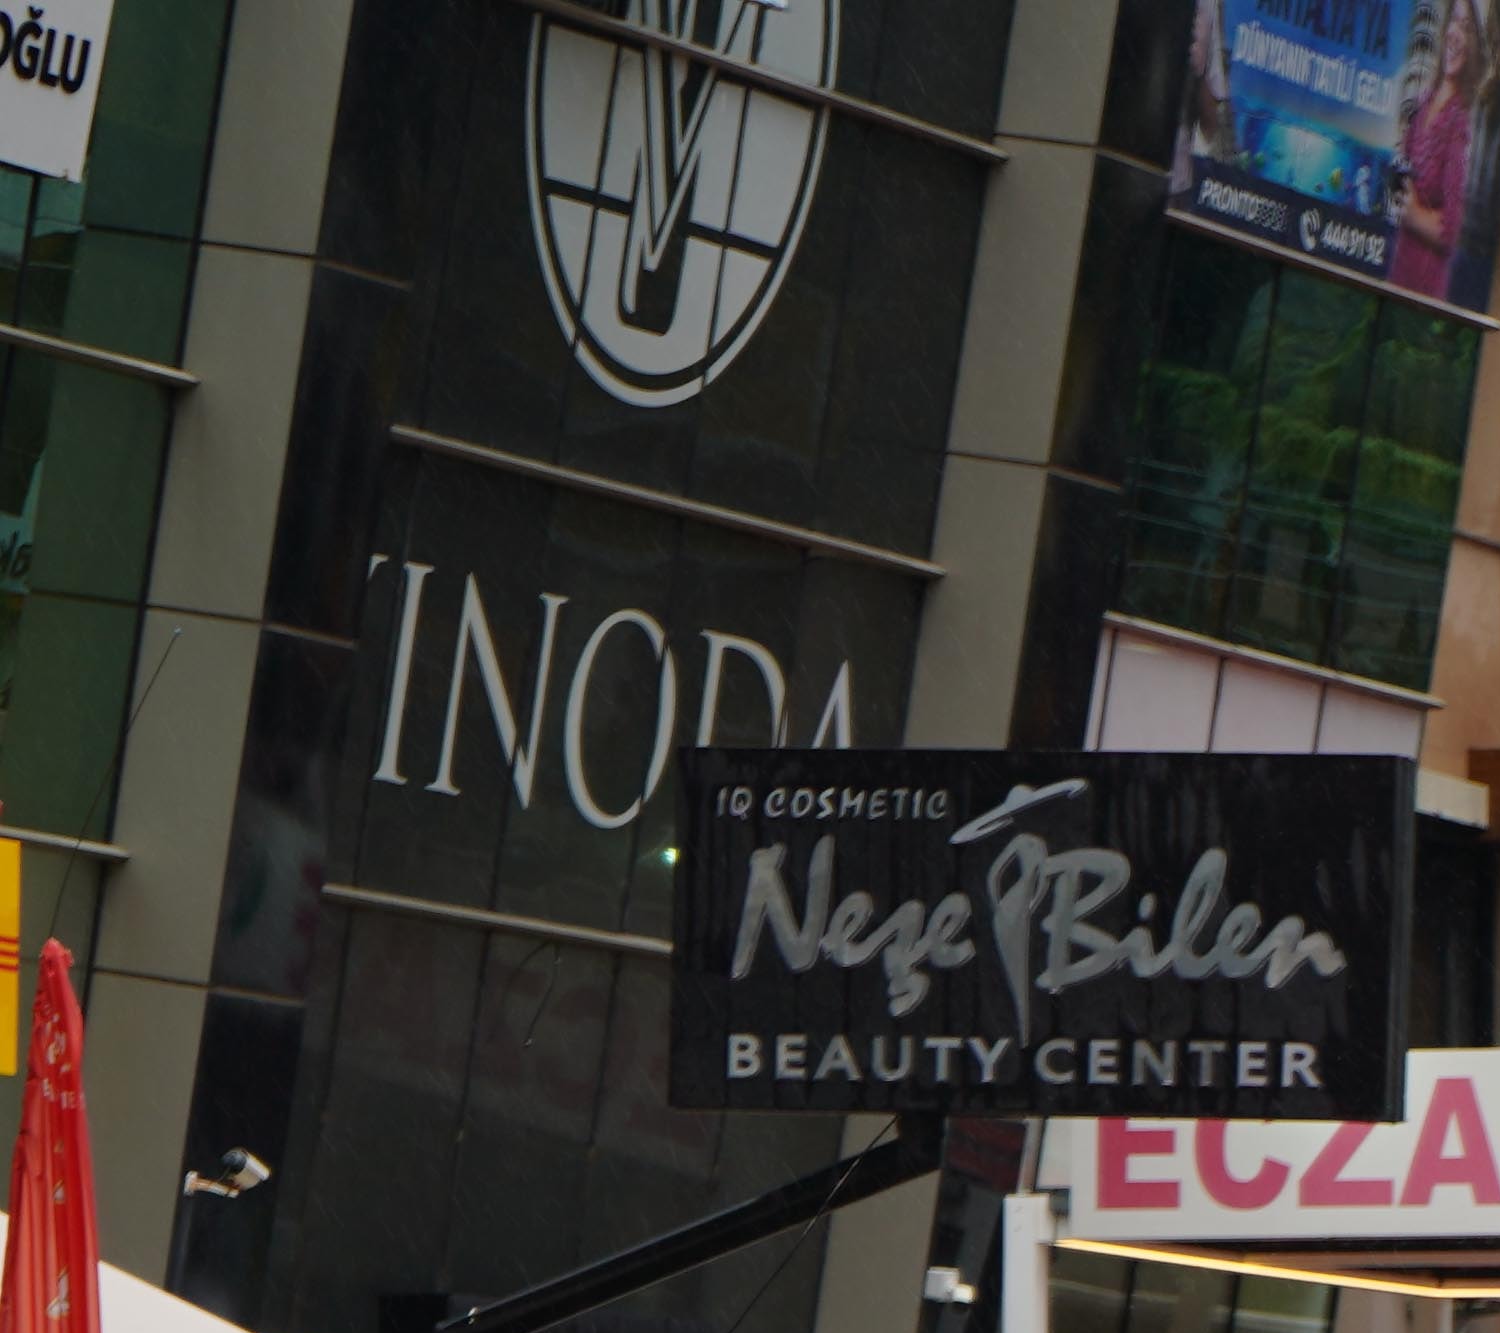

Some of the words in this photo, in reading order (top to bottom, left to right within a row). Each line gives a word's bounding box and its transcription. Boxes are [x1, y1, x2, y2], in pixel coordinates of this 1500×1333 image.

[716, 786, 752, 818] IQ
[764, 788, 949, 820] COSMETIC
[730, 834, 976, 1017] Neşe
[1035, 846, 1347, 994] Bilen
[727, 1034, 1011, 1082] BEAUTY
[1034, 1040, 1323, 1087] CENTER
